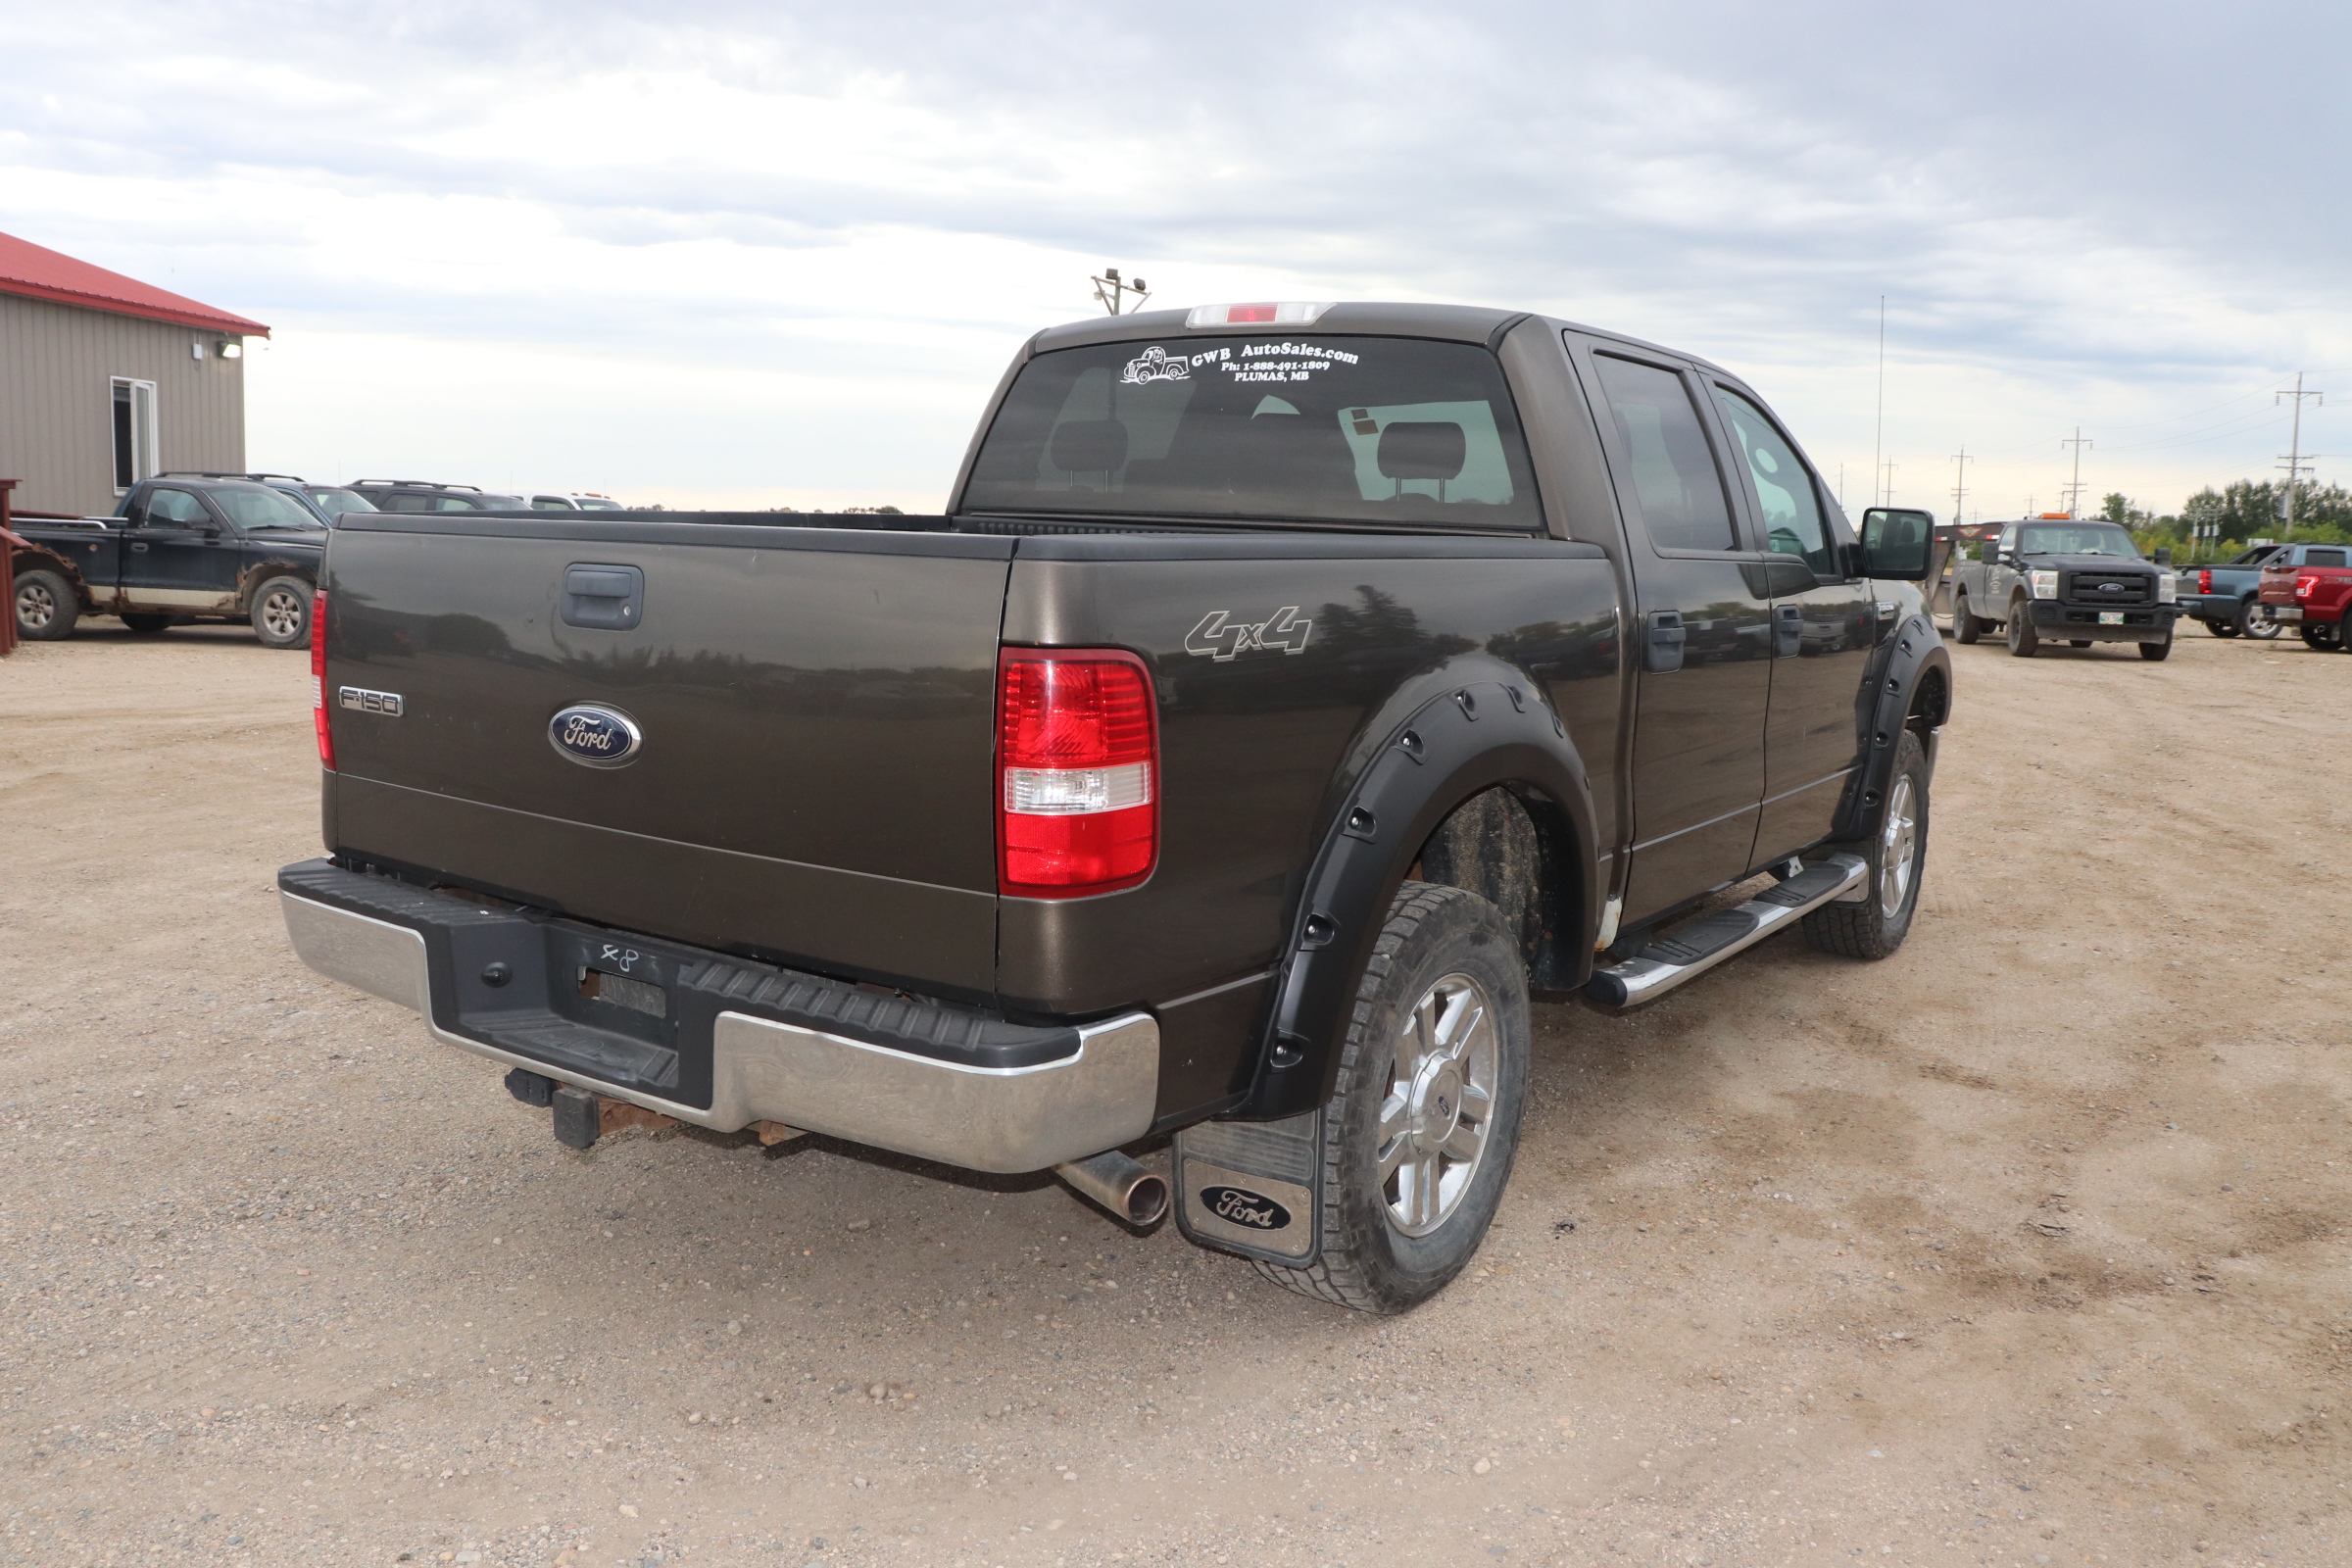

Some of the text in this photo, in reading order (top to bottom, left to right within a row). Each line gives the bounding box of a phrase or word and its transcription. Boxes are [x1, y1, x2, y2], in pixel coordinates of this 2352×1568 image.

[1192, 342, 1359, 368] GWB AutoSales.com
[1221, 362, 1330, 371] Ph: 1-888-491-1809
[1235, 371, 1309, 382] PLUMAS, MB
[564, 715, 612, 750] Ford
[1216, 1190, 1274, 1226] Ford
